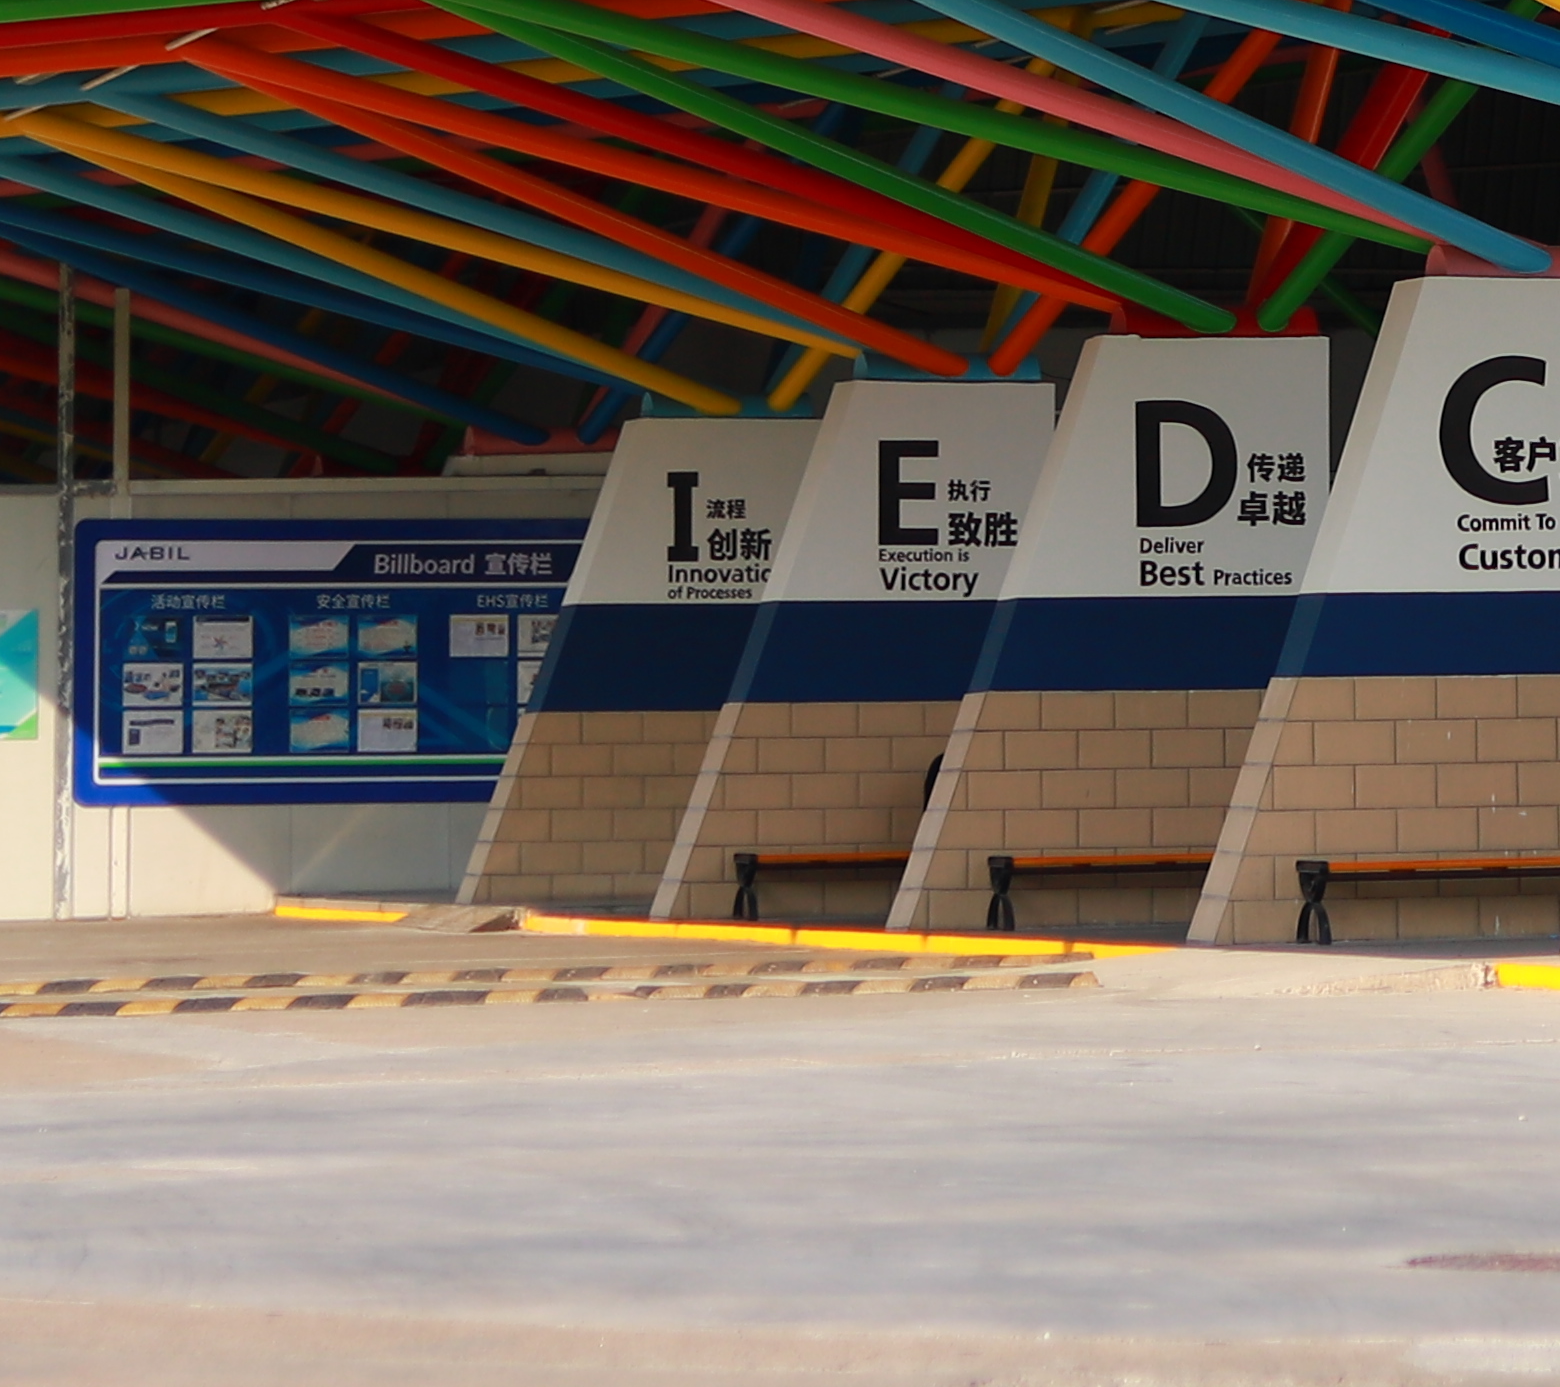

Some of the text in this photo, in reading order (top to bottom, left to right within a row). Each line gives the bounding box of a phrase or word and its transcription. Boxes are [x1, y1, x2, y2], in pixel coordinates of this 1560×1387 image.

[1440, 355, 1549, 505] C
[1136, 400, 1238, 527] D
[1247, 453, 1306, 483] 传递
[878, 440, 939, 545] E
[947, 479, 991, 502] 执行
[667, 471, 699, 562] I
[706, 499, 746, 520] 流程
[1237, 491, 1306, 526] 卓越
[947, 511, 1018, 548] 致胜
[1457, 513, 1557, 532] Commit To
[114, 546, 191, 561] JABIL
[707, 528, 772, 562] 创新
[878, 548, 970, 563] Execution is
[1140, 537, 1205, 555] Deliver
[373, 553, 552, 576] Billboard 宣传栏
[1140, 560, 1293, 587] Best Practices
[667, 586, 752, 600] of Processes
[880, 566, 980, 598] Victory
[151, 593, 226, 611] 活动宣传栏
[316, 593, 390, 610] 安全宣传栏
[477, 593, 549, 610] EHS宣传栏
